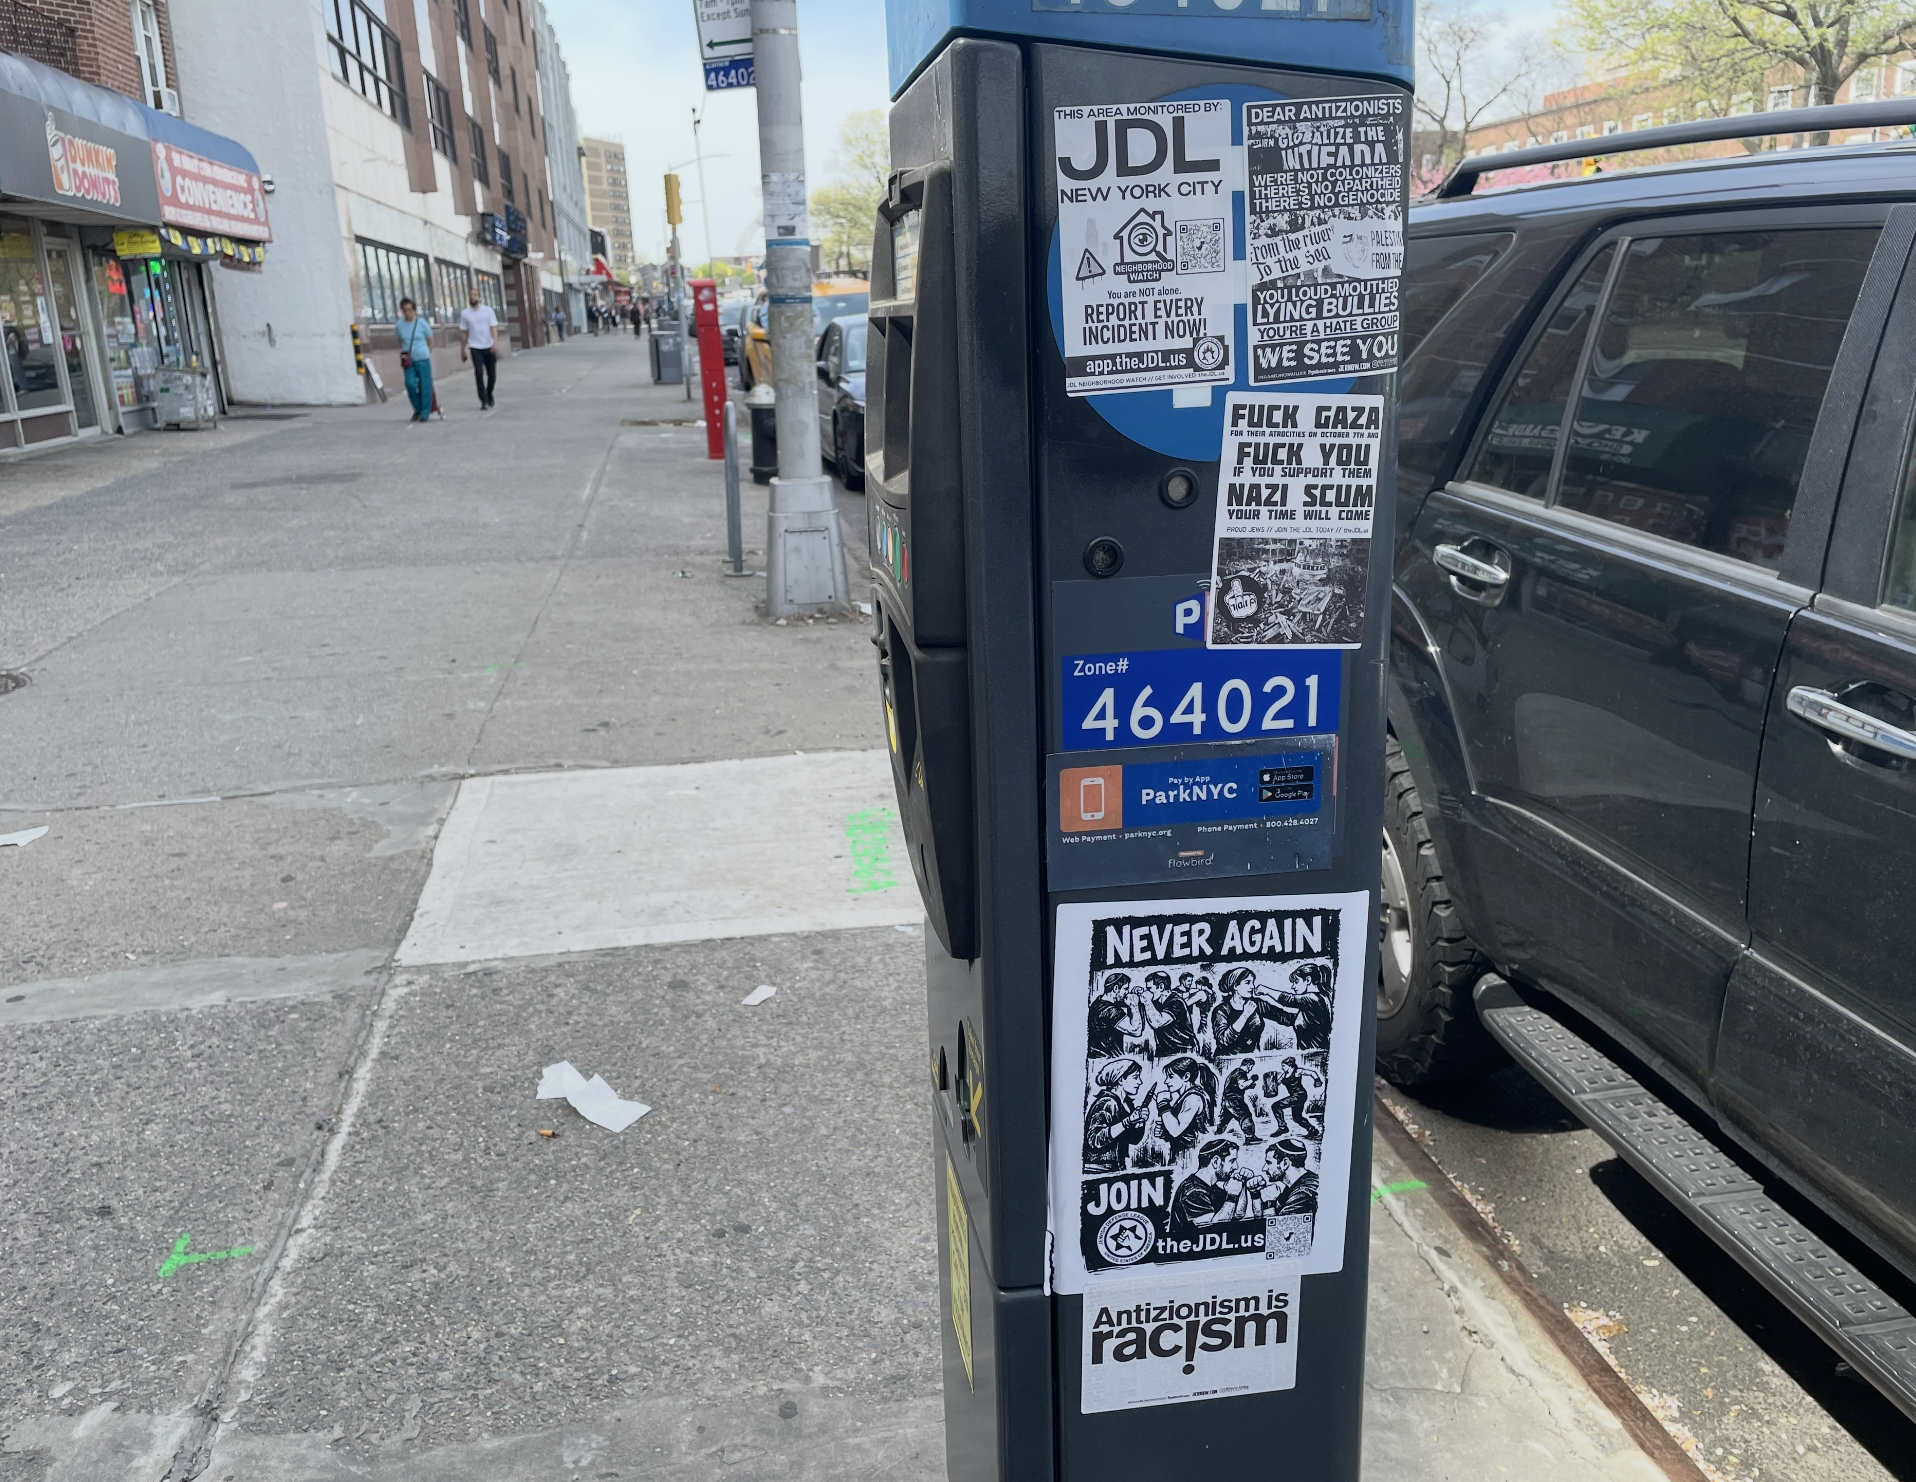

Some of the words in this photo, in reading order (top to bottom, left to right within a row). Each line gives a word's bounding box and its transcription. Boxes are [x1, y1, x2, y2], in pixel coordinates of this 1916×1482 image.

[700, 9, 731, 22] Except
[1055, 109, 1084, 120] THIS
[1087, 107, 1123, 118] AREA
[1126, 102, 1201, 117] MONITORED
[1204, 101, 1223, 112] BY:
[1251, 105, 1296, 123] DEAR
[1299, 98, 1403, 120] ANTIZIONISTS
[1058, 115, 1221, 181] JDL
[1278, 127, 1354, 149] GLOBALIZE
[1358, 126, 1386, 142] THE
[72, 167, 121, 207] DONUTS
[1253, 172, 1295, 187] WE'RE
[1298, 170, 1324, 183] NOT
[1327, 164, 1402, 181] COLONIZERS
[176, 175, 256, 219] CONVENIENCE
[1060, 186, 1111, 204] NEW
[1116, 182, 1172, 200] YORK
[1177, 179, 1223, 197] CITY
[1253, 183, 1308, 200] THERE'S
[1312, 182, 1332, 195] NO
[1335, 177, 1401, 193] APARTHEID
[1253, 195, 1311, 212] THERE'S
[1314, 193, 1335, 207] NO
[1338, 188, 1401, 205] GENOCIDE
[1280, 235, 1302, 254] the
[1303, 228, 1332, 247] river
[1115, 262, 1173, 273] NEIGHBORHOOD
[1252, 261, 1272, 281] To
[1274, 255, 1302, 274] the
[1371, 252, 1391, 269] FROM
[1129, 272, 1159, 281] WATCH
[1107, 290, 1122, 300] You
[1123, 290, 1137, 298] are
[1138, 287, 1156, 297] NOT
[1157, 286, 1182, 296] alone.
[1256, 289, 1288, 304] YOU
[1291, 279, 1399, 301] LOUD-MOUTHED
[1084, 301, 1148, 324] REPORT
[1153, 296, 1204, 320] EVERY
[1256, 300, 1317, 324] LYING
[1322, 291, 1399, 318] BULLIES
[1082, 321, 1159, 346] INCIDENT
[1164, 318, 1207, 340] NOW!
[1258, 323, 1308, 340] YOU'RE
[1310, 323, 1321, 335] A
[1323, 319, 1358, 334] HATE
[1361, 314, 1398, 330] GROUP
[1086, 352, 1187, 375] app.theJDL.us
[1257, 343, 1298, 370] WE
[1303, 339, 1352, 365] SEE
[1357, 334, 1398, 360] YOU
[1078, 378, 1124, 387] NEIGHBORHOOD
[1126, 375, 1147, 384] WATCH
[1231, 404, 1299, 428] FUCK
[1314, 406, 1380, 430] GAZA
[1269, 430, 1306, 438] ATROCITIES
[1236, 442, 1304, 466] FUCK
[1319, 443, 1371, 467] YOU
[1232, 466, 1244, 477] IF
[1251, 466, 1275, 478] YOU
[1280, 467, 1335, 478] SUPPORT
[1341, 467, 1372, 479] THEM
[1226, 483, 1289, 507] NAZI
[1302, 483, 1373, 508] SCUM
[1227, 508, 1261, 521] YOUR
[1267, 509, 1297, 521] TIME
[1303, 509, 1331, 521] WILL
[1338, 509, 1371, 521] COME
[1175, 599, 1201, 634] P
[1073, 657, 1129, 677] Zone#
[1081, 674, 1319, 741] 464021
[1168, 777, 1182, 785] Pay
[1184, 776, 1193, 785] by
[1141, 782, 1238, 805] ParkNYC
[1274, 791, 1297, 799] Google
[1062, 835, 1079, 844] Web
[1081, 833, 1116, 843] Payment
[1124, 828, 1172, 840] parknyc.org
[1197, 825, 1222, 834] Phone
[1223, 822, 1257, 833] Payment
[1266, 817, 1319, 829] 800.428.4027
[1106, 921, 1214, 966] NEVER
[1220, 915, 1322, 956] AGAIN
[1087, 1176, 1164, 1215] JOIN
[1098, 1226, 1107, 1245] JEWISH
[1105, 1212, 1129, 1227] DEFENSE
[1130, 1212, 1150, 1225] LEAGUE
[1156, 1233, 1265, 1255] theJDL.us
[1104, 1251, 1120, 1263] UNITED
[1093, 1294, 1260, 1329] Antizionism
[1267, 1289, 1289, 1311] is
